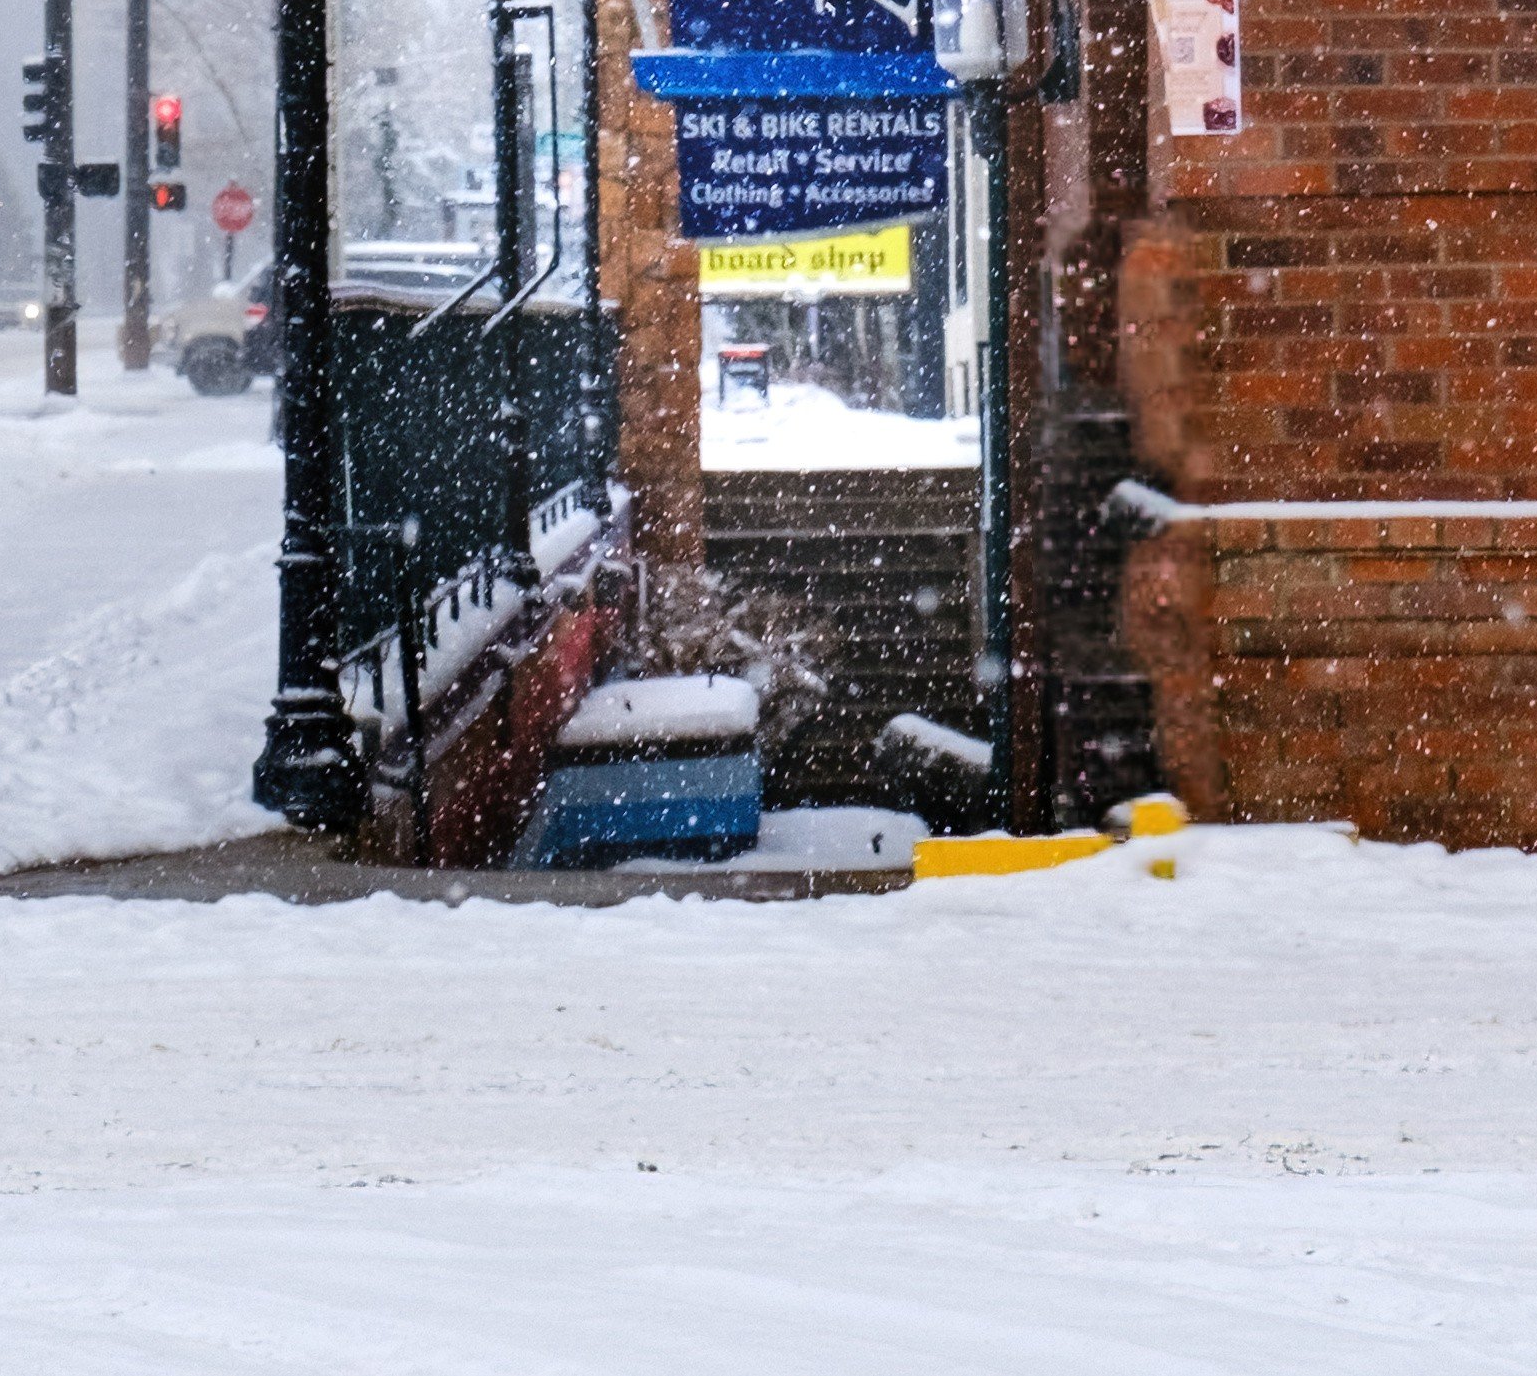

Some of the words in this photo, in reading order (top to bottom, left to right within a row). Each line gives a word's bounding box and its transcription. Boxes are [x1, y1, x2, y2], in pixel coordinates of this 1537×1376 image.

[682, 112, 726, 140] SKI
[732, 114, 756, 139] &
[762, 111, 821, 138] BIKE
[826, 110, 941, 138] RENTALS
[712, 149, 789, 174] Retail
[814, 147, 913, 174] Service
[690, 182, 784, 208] Clothing
[804, 180, 935, 204] Accessories
[708, 244, 796, 271] board
[811, 245, 885, 275] shop
